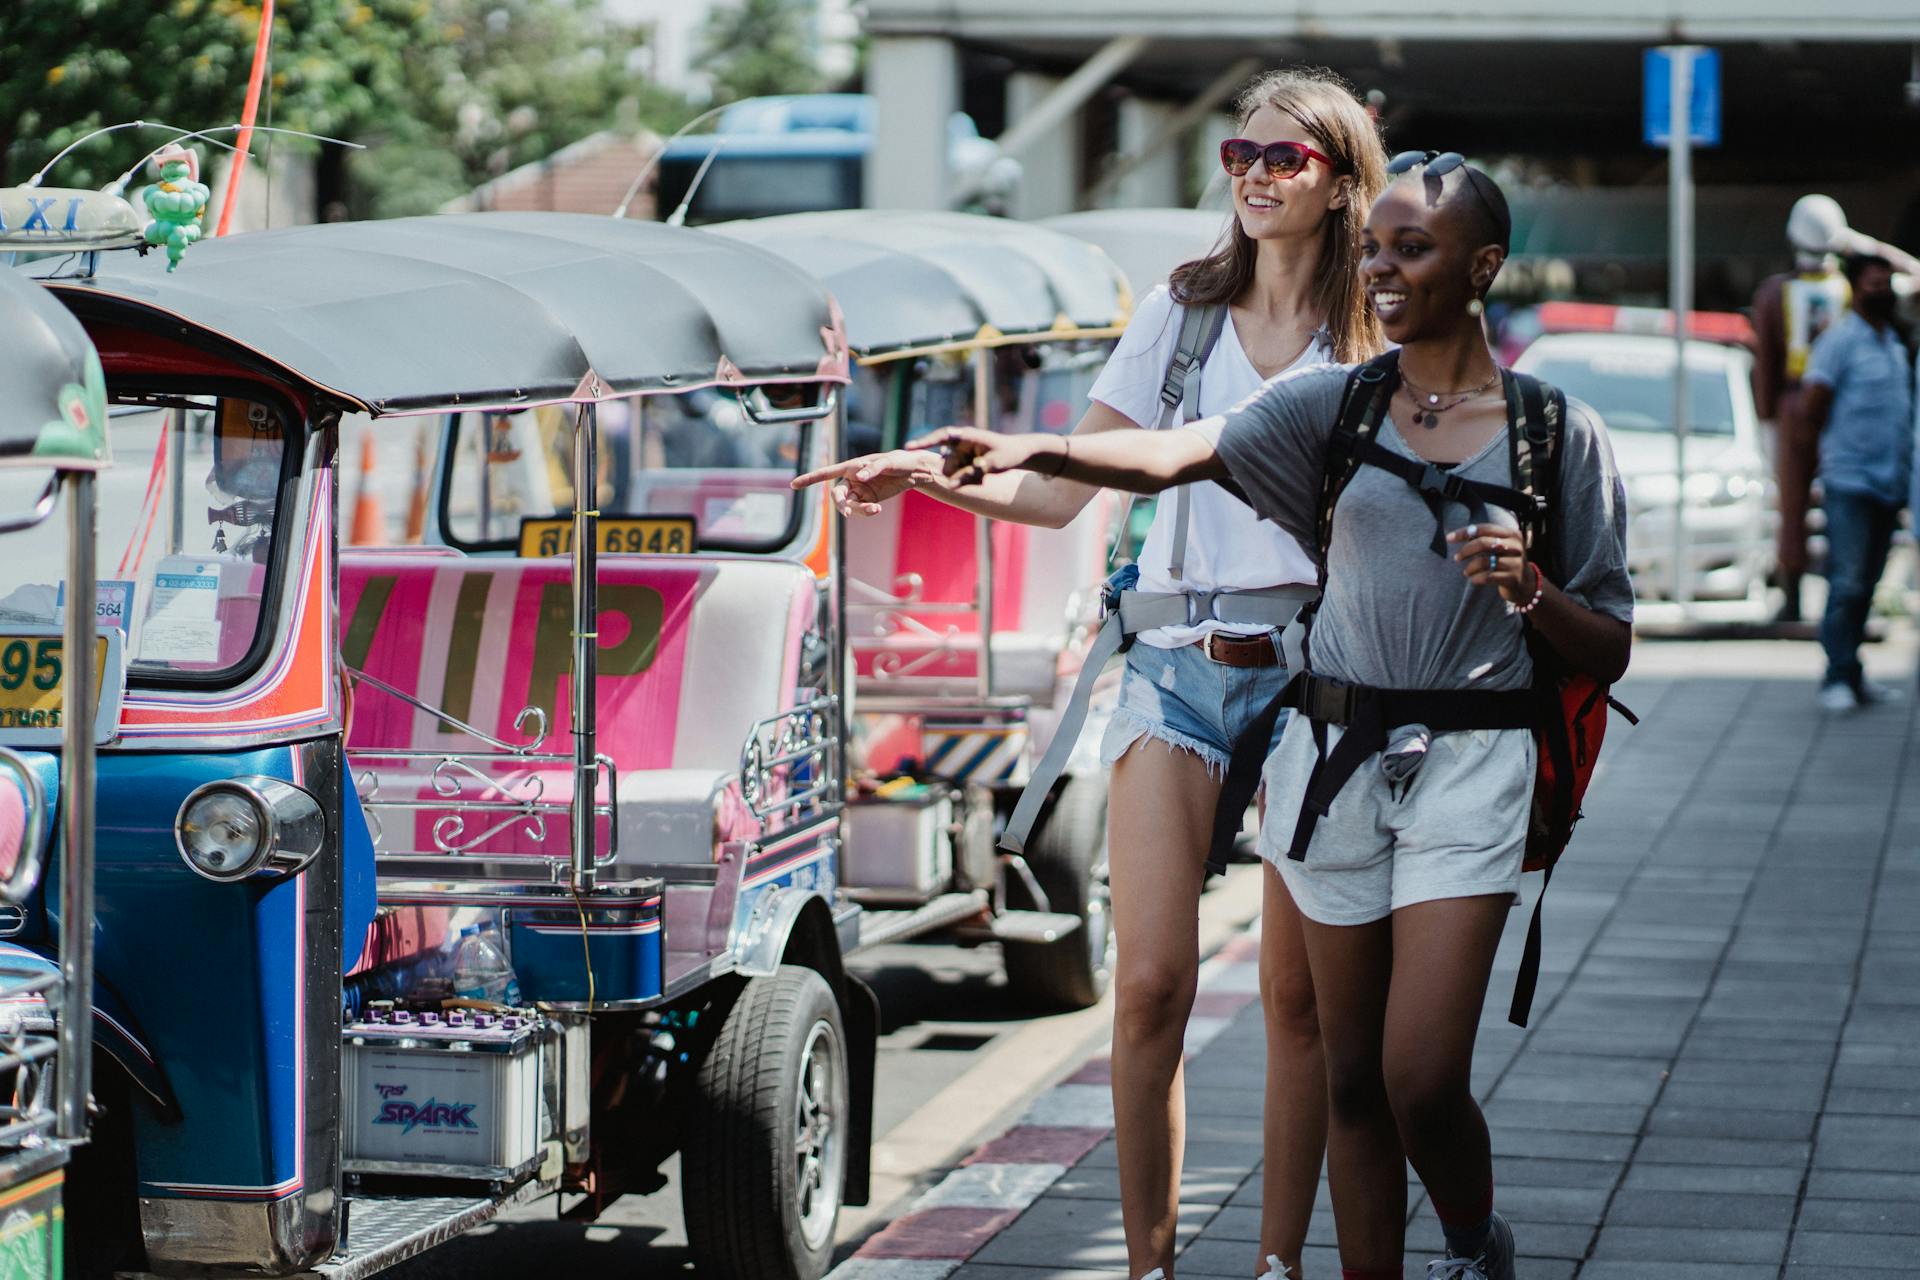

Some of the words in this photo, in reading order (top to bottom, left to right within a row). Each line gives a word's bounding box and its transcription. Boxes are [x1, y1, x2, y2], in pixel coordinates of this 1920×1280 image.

[0, 197, 84, 231] XI
[606, 527, 684, 553] 6948
[96, 602, 122, 616] 564
[373, 1099, 478, 1128] SPARK
